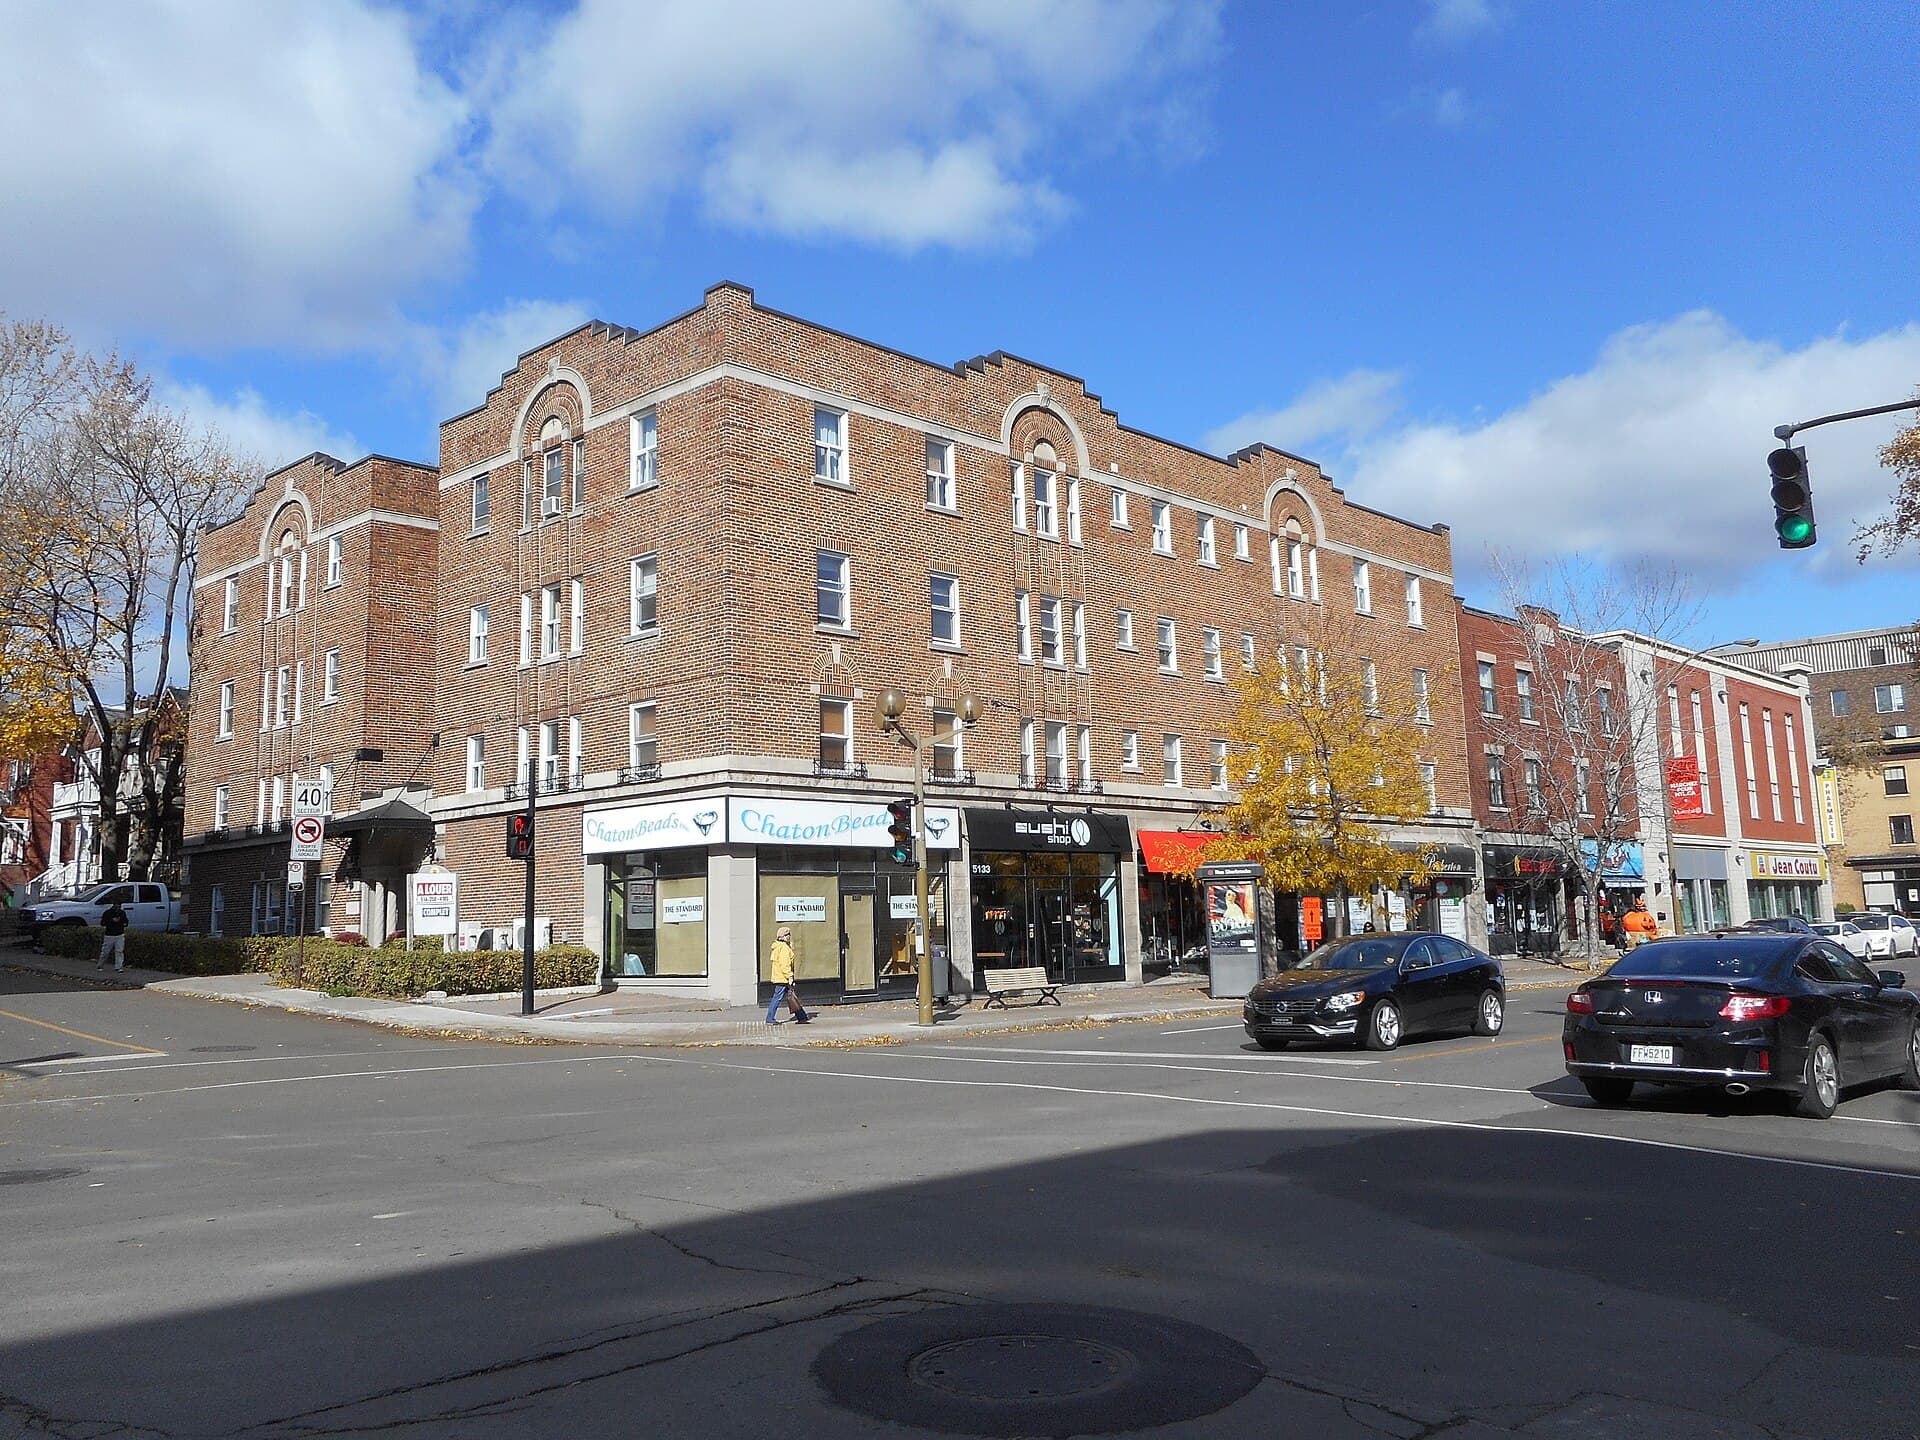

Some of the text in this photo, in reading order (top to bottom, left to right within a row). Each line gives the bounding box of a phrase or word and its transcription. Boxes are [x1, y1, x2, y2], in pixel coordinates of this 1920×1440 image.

[297, 788, 321, 806] 40
[1825, 783, 1835, 838] PHARMACIE
[1015, 818, 1069, 835] sushi
[1047, 831, 1071, 846] shop
[972, 865, 991, 873] 5133
[1772, 858, 1818, 875] Jean Coutu
[675, 905, 702, 913] STANDARD
[777, 904, 824, 912] THE STANDARD
